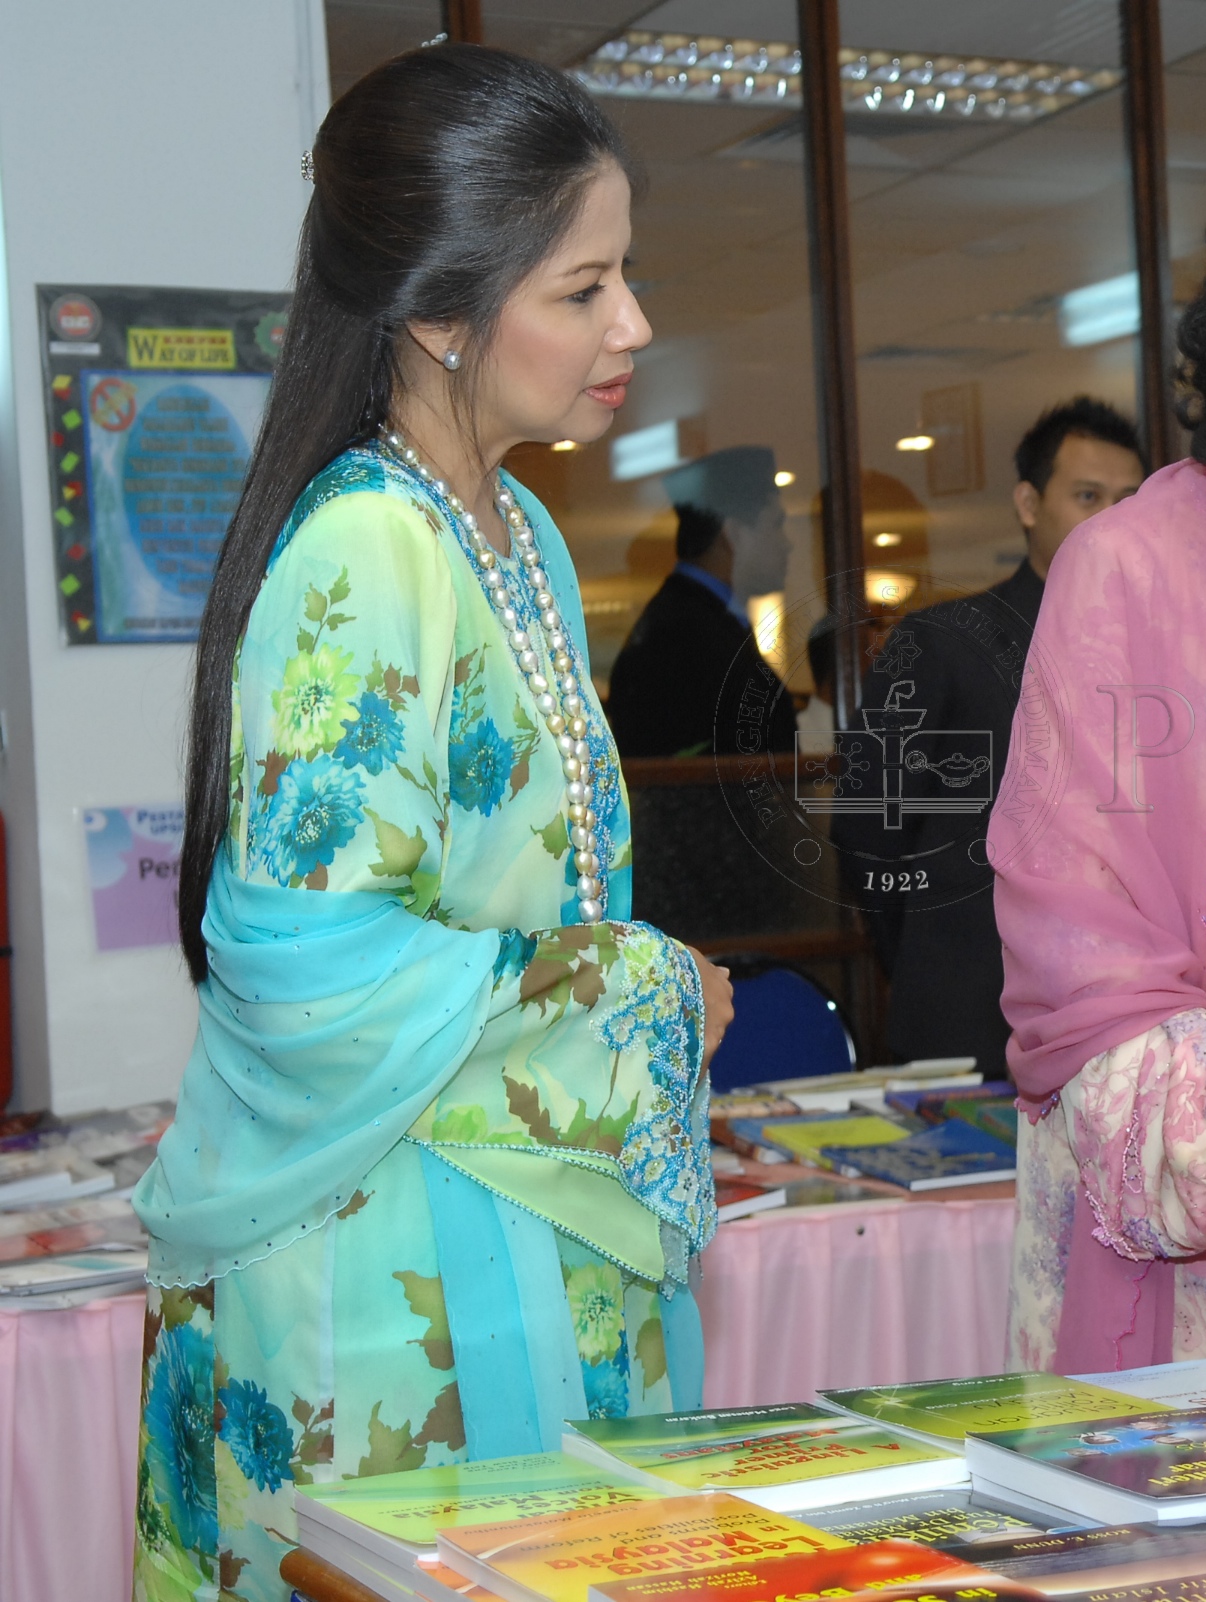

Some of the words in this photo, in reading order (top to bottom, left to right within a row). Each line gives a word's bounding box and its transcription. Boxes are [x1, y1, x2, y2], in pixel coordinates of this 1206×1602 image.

[926, 1402, 957, 1411] Cina
[974, 1403, 1142, 1429] Ketuanan
[661, 1428, 838, 1460] Malaysians
[749, 1440, 800, 1455] for
[871, 1442, 900, 1452] A
[734, 1443, 846, 1466] Primer
[701, 1448, 867, 1479] Linguistic
[558, 1485, 615, 1498] from
[391, 1494, 541, 1520] Malaysia
[515, 1492, 632, 1513] Voices
[930, 1506, 965, 1517] bin
[953, 1511, 1002, 1523] Tun
[635, 1513, 756, 1532] Possibilities
[668, 1518, 769, 1536] Problems
[758, 1524, 789, 1533] in
[911, 1517, 949, 1527] Dr.
[608, 1530, 630, 1539] of
[619, 1533, 662, 1545] and
[1087, 1530, 1131, 1540] ROSS
[520, 1536, 601, 1552] Reform
[544, 1530, 759, 1570] Malaysia
[1013, 1539, 1066, 1551] DUNN
[607, 1535, 824, 1576] Learning
[626, 1580, 682, 1591] Hassan
[707, 1575, 757, 1586] Azirah
[864, 1573, 923, 1591] and
[642, 1584, 702, 1595] Hashim
[1088, 1586, 1166, 1601] Islam
